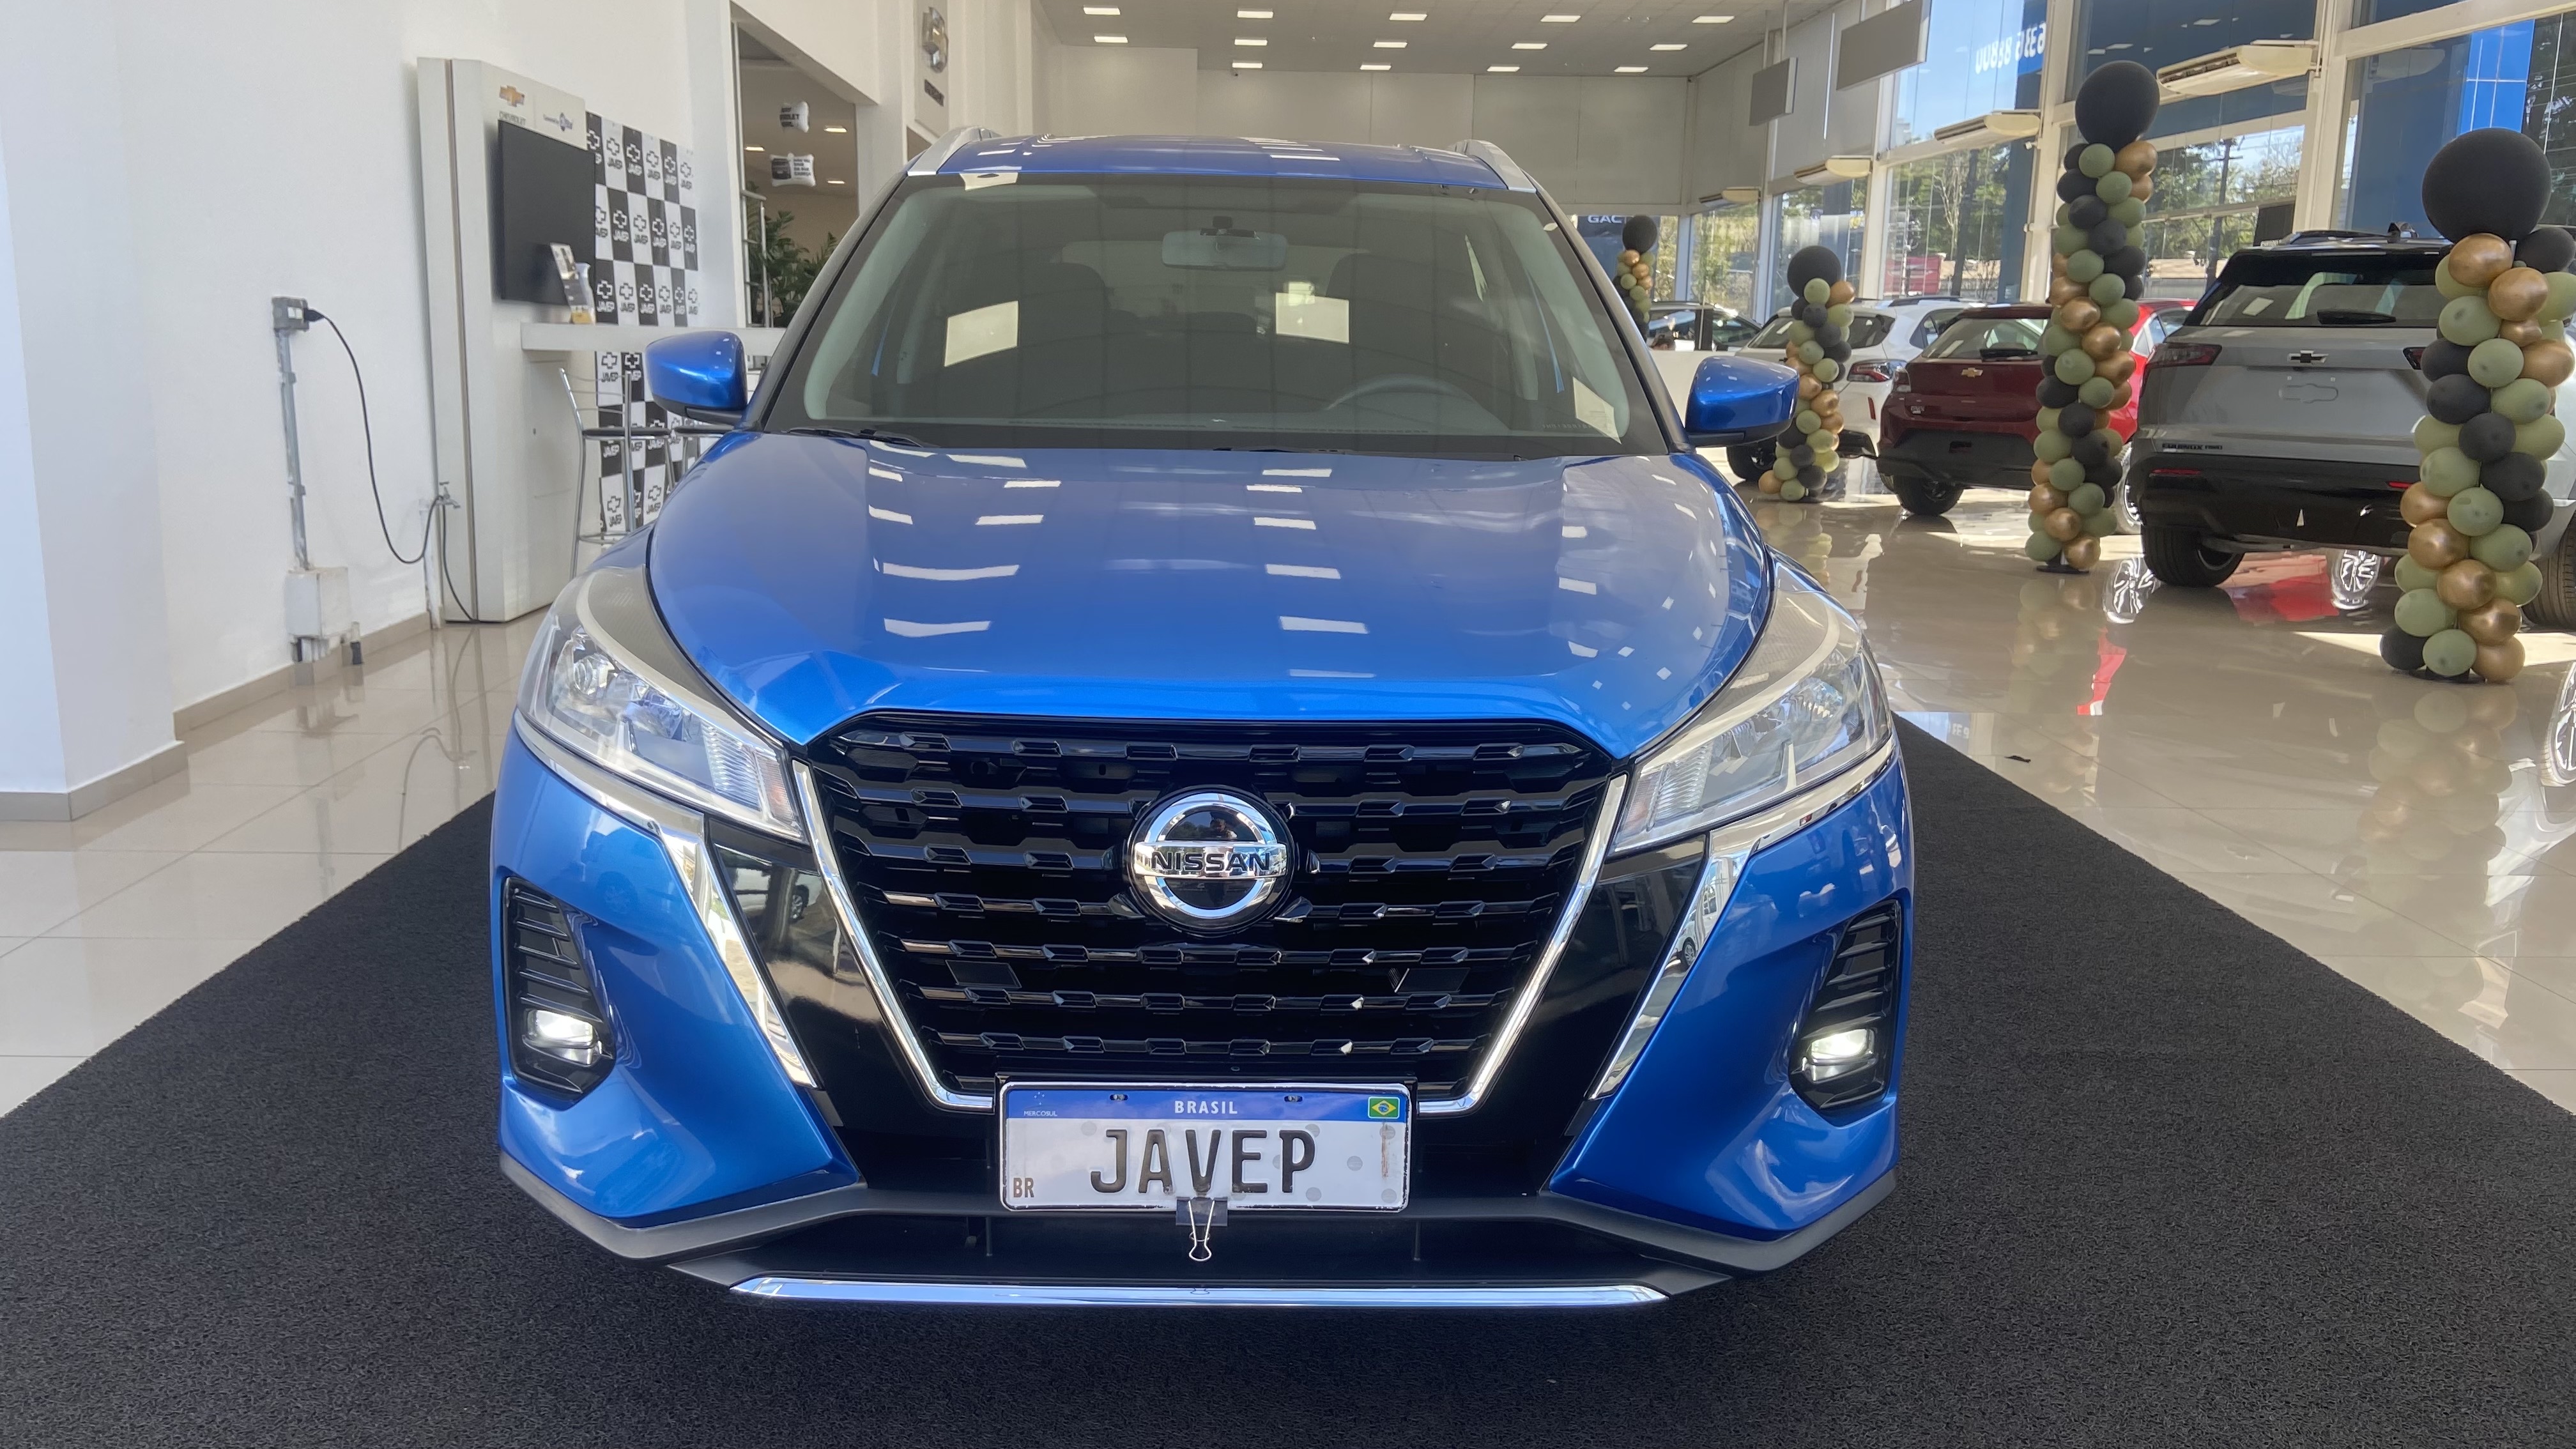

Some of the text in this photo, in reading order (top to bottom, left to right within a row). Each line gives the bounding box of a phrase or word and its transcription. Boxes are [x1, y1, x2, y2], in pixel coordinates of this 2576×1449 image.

[1588, 215, 1622, 224] GAC
[1151, 850, 1271, 871] NISSAN
[1174, 1100, 1238, 1114] BRASIL
[1090, 1129, 1315, 1193] JAVEP
[1013, 1177, 1034, 1198] BR
